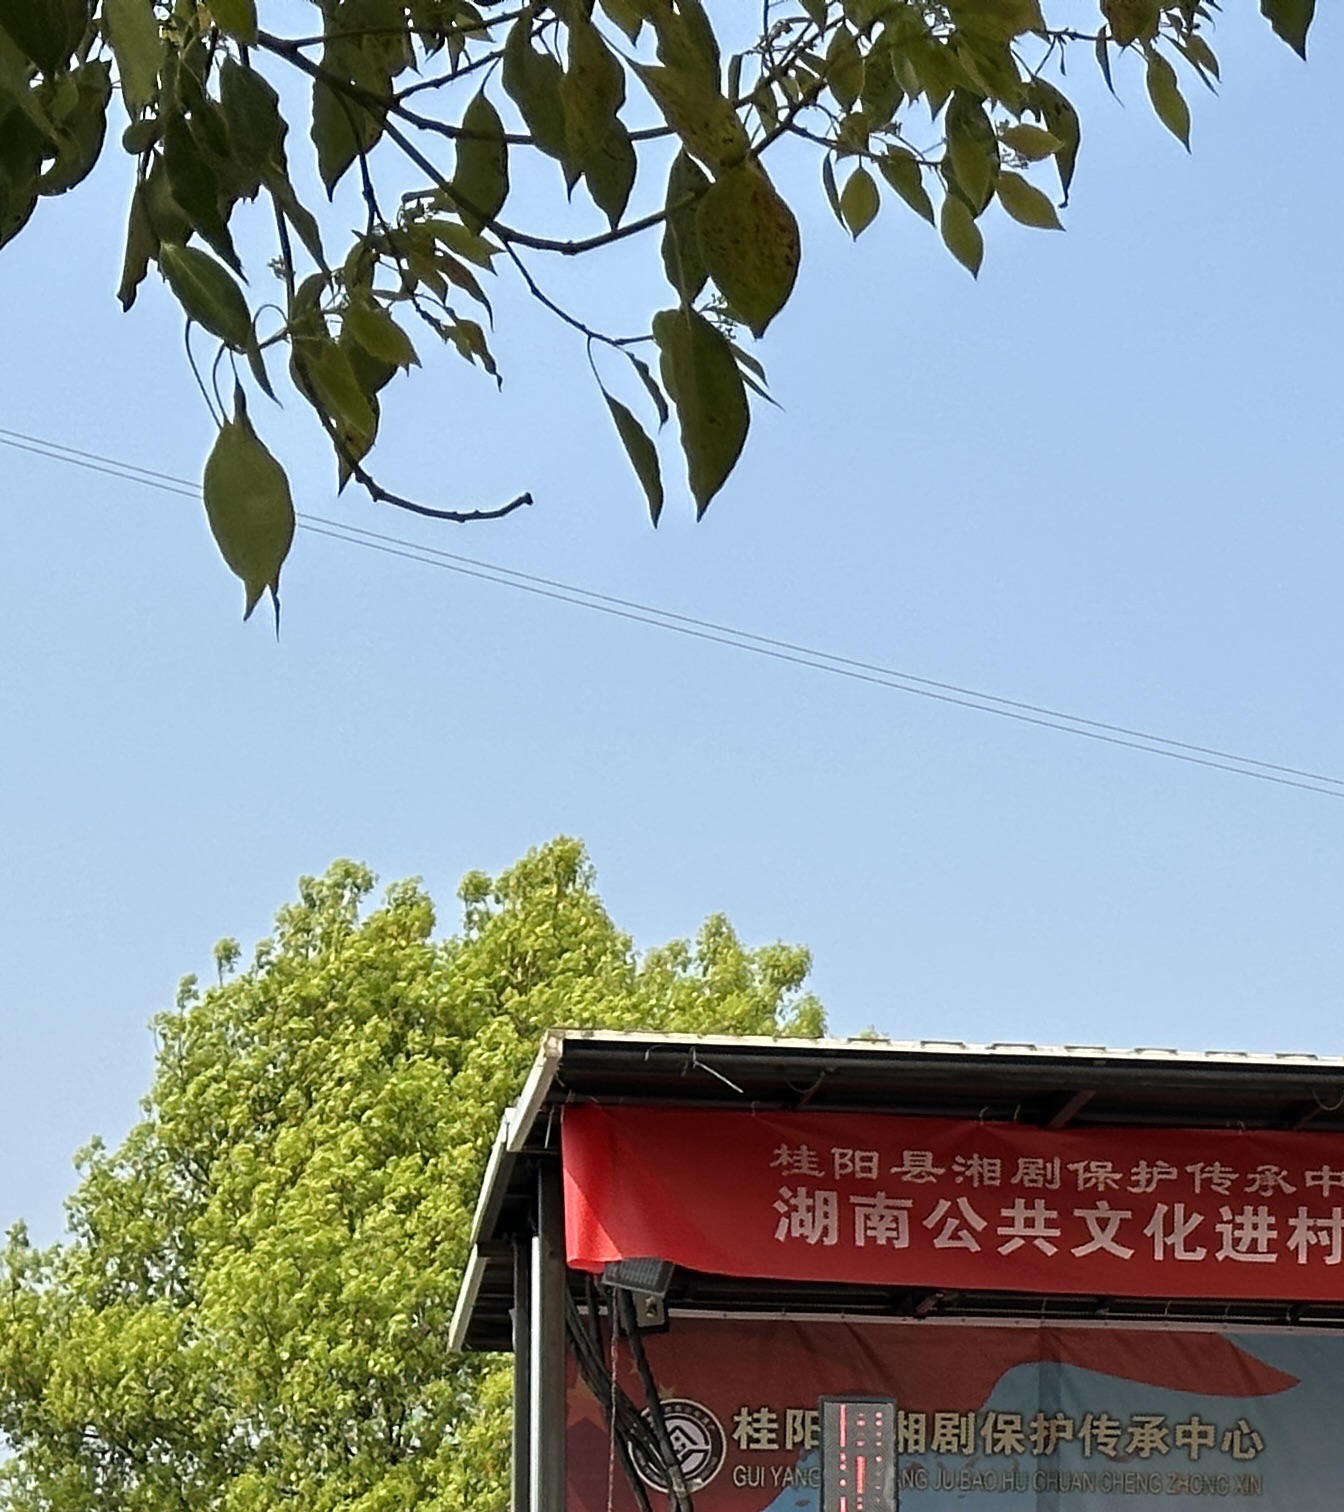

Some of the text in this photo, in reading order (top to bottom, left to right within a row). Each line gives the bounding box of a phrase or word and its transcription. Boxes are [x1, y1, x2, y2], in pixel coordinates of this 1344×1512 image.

[732, 1406, 1265, 1461] 桂阳湘剧保护传承中心
[733, 1464, 765, 1488] GUI
[933, 1469, 955, 1492] JU
